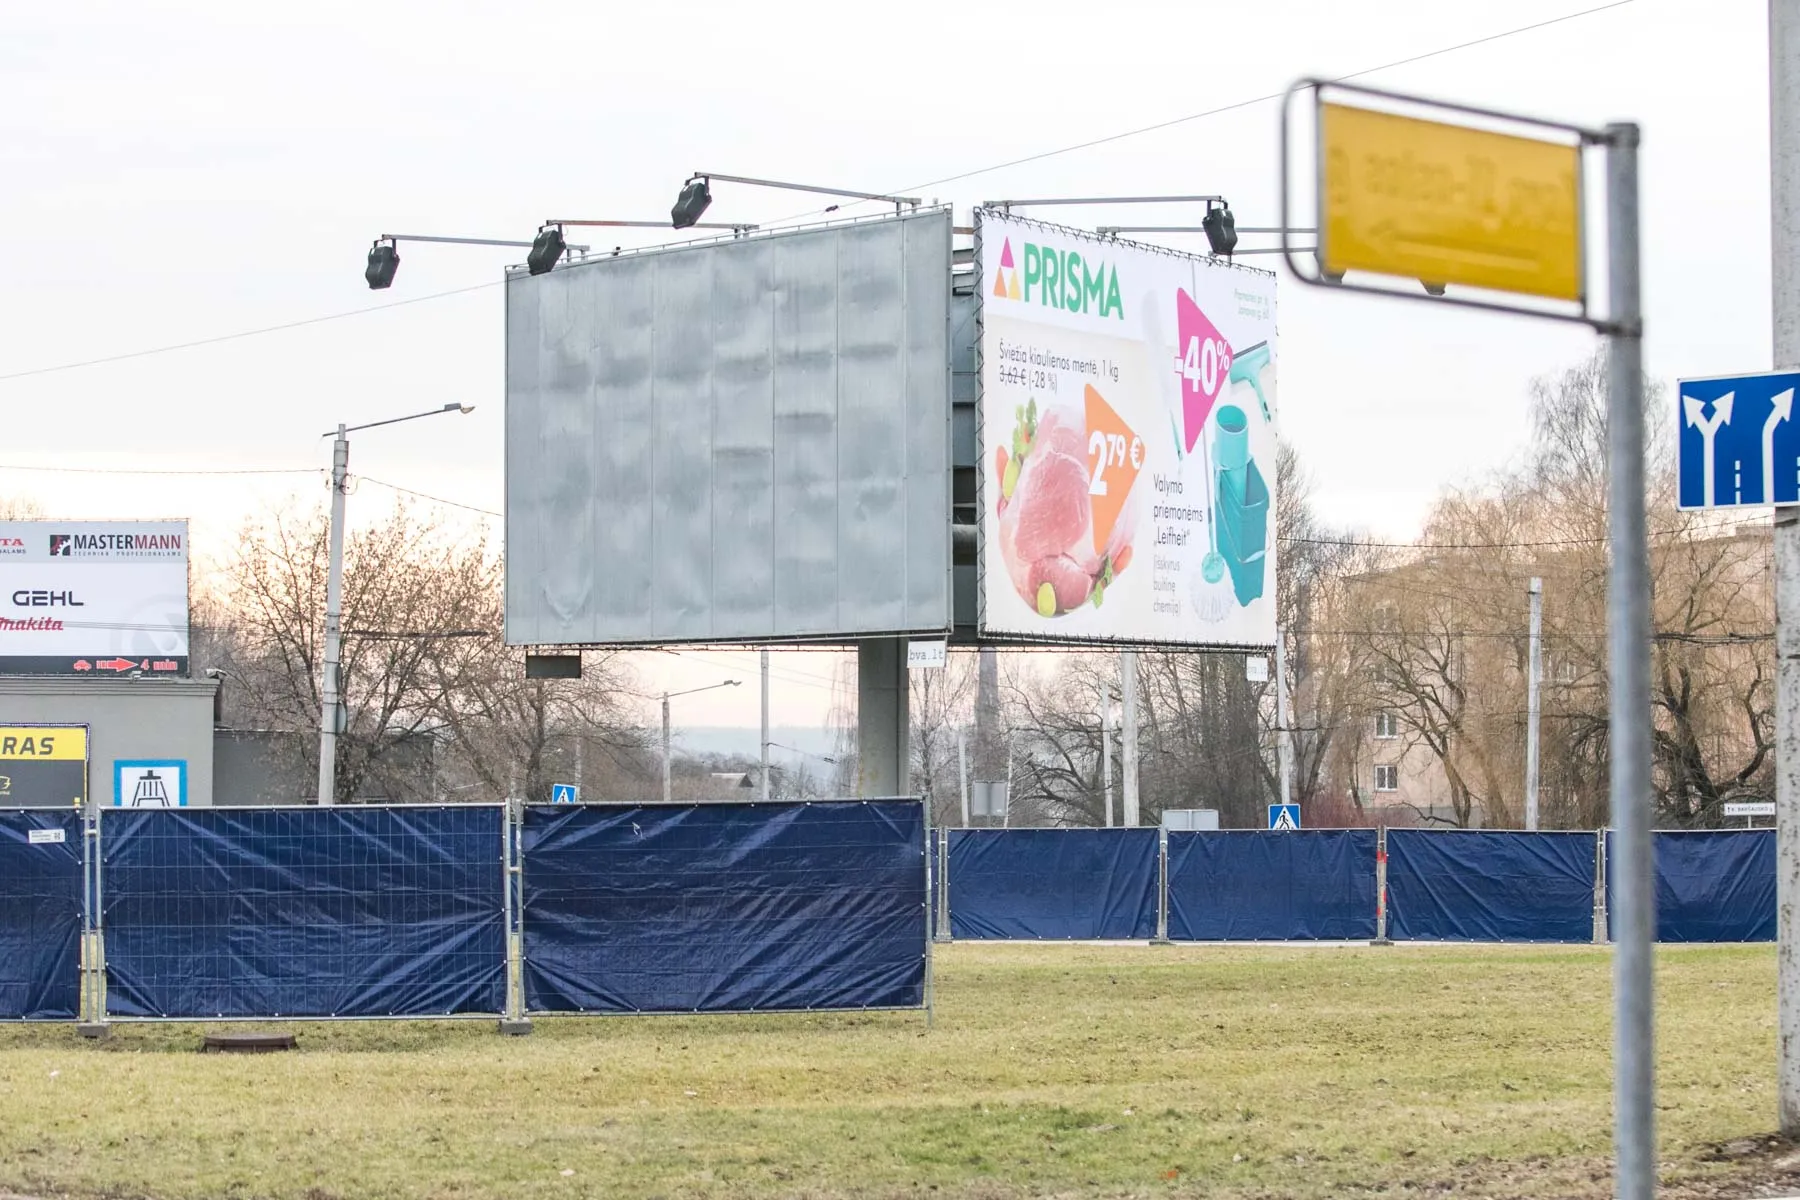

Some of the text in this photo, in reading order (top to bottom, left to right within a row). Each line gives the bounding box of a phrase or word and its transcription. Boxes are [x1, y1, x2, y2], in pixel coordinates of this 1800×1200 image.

[1024, 242, 1124, 320] PRISMA
[999, 337, 1119, 383] Šviežia kiaulienos mentė, 1 kg
[1129, 435, 1142, 470] €
[1153, 473, 1183, 497] Valymo
[1153, 500, 1203, 523] priemonėms
[74, 534, 181, 549] MASTERMANN
[12, 591, 84, 606] GEHL
[908, 648, 944, 660] bva.lt
[140, 658, 177, 671] 4 min
[2, 737, 55, 755] RAS
